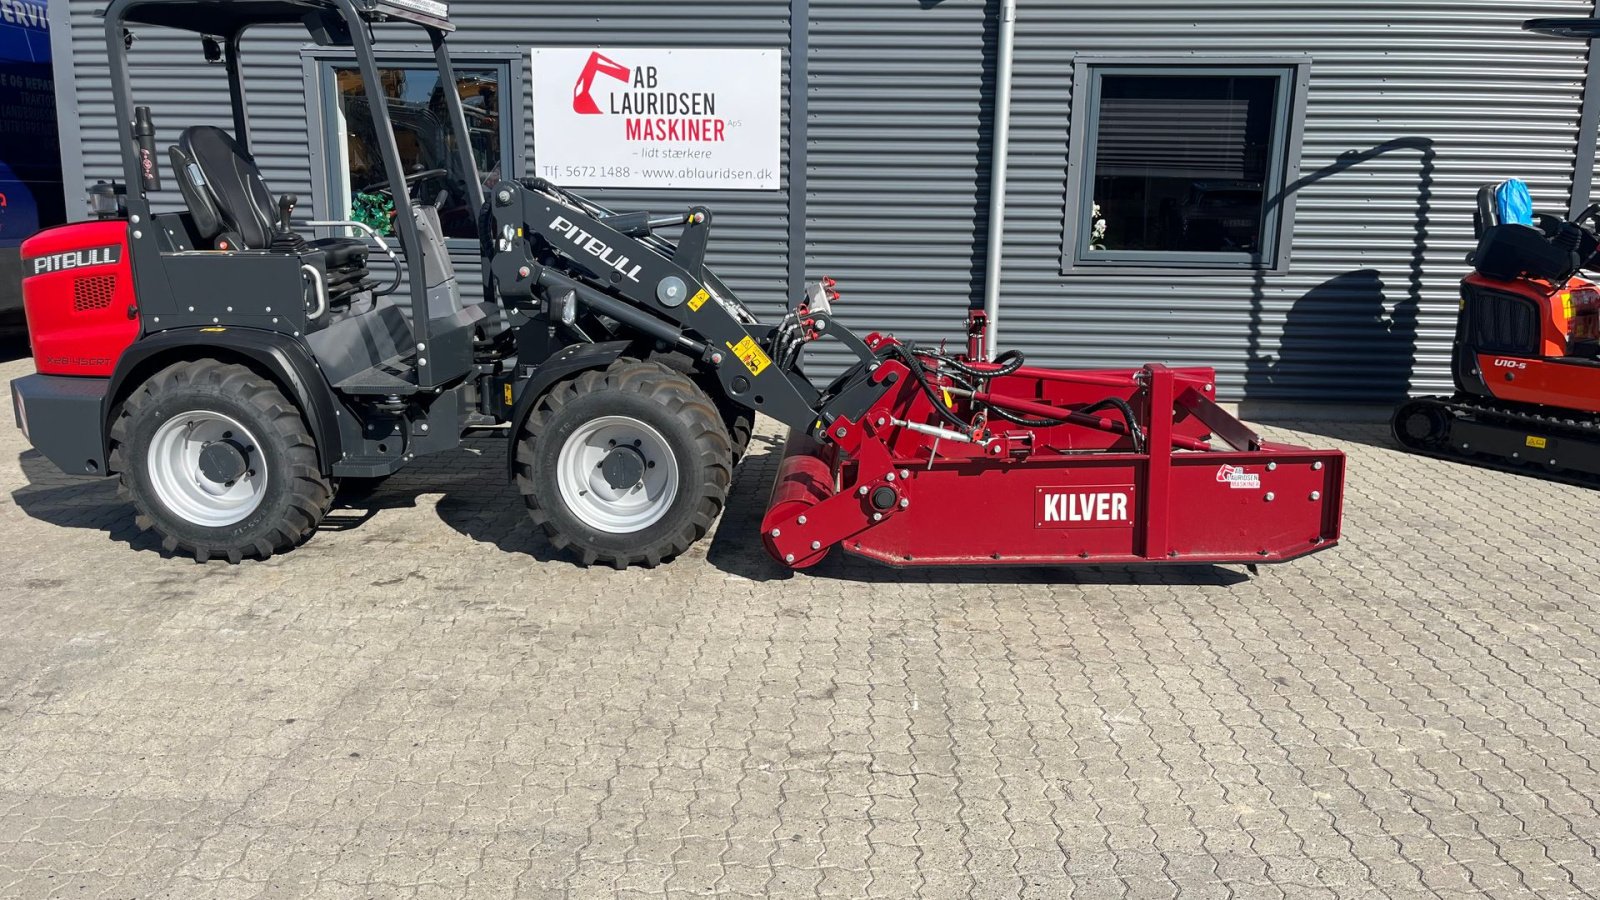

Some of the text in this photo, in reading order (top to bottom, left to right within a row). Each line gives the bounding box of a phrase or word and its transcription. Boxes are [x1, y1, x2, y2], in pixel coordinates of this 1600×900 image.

[0, 0, 49, 29] ERVI
[633, 66, 658, 89] AB
[610, 92, 715, 116] LAURIDSEN
[625, 118, 742, 142] MASKINER ApS
[641, 147, 659, 159] lidt
[662, 148, 712, 160] stærkere
[543, 165, 563, 179] Tlf.
[565, 166, 597, 178] 5672
[600, 166, 631, 178] 1488
[642, 167, 773, 180] www.ablauridsen.dk
[34, 247, 117, 275] PITBULL
[549, 215, 642, 283] PITBULL
[1044, 492, 1128, 522] KILVER
